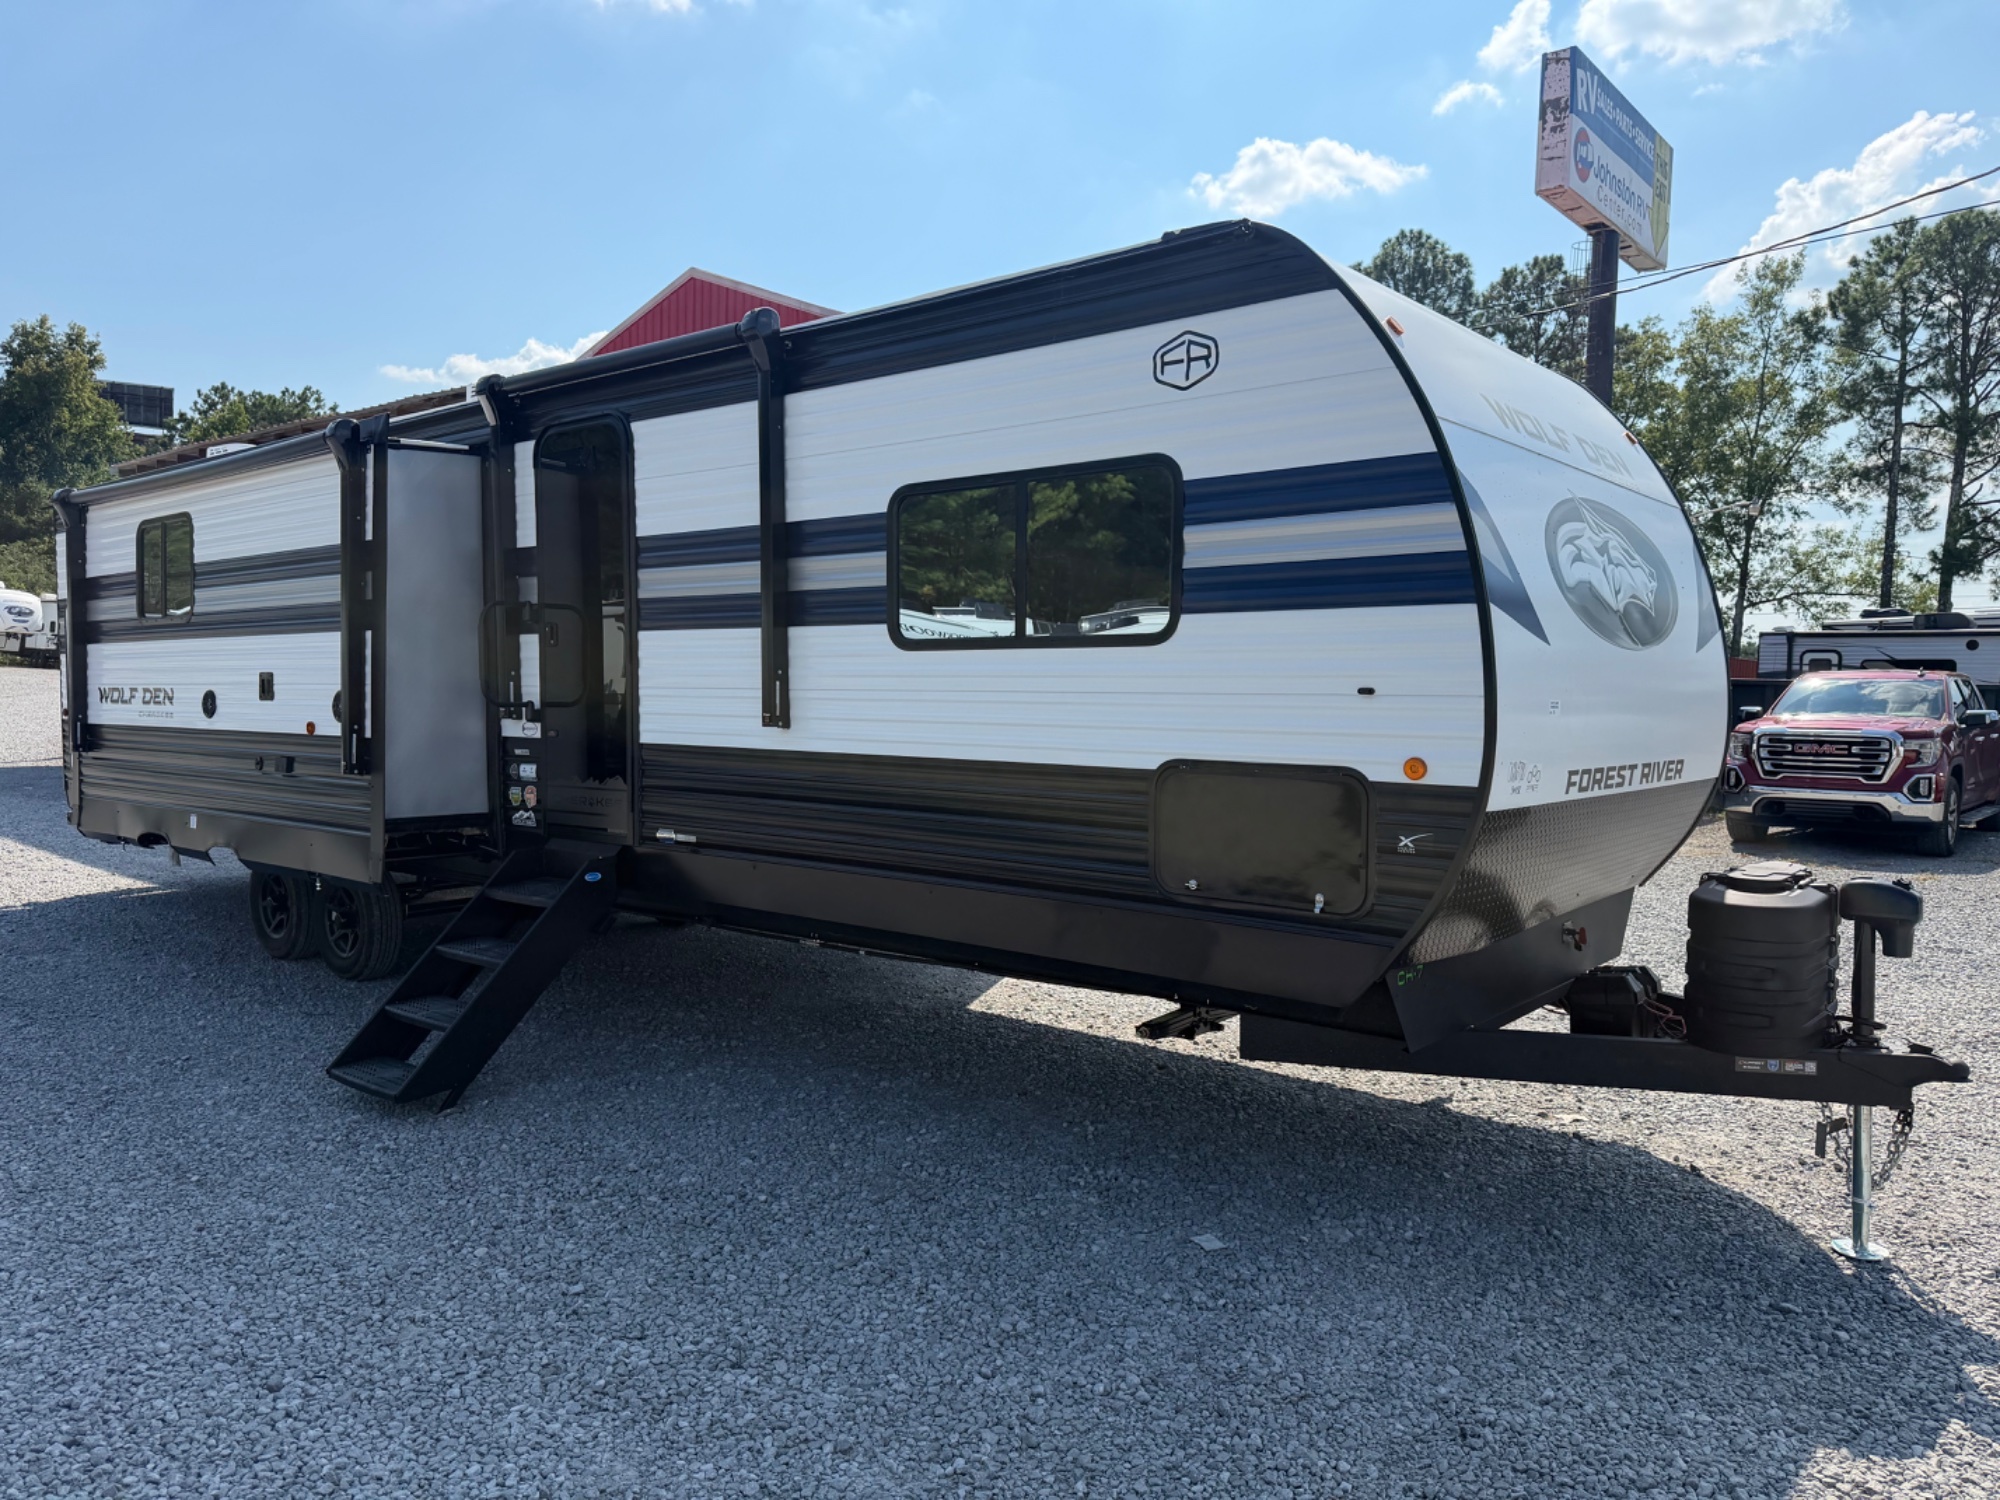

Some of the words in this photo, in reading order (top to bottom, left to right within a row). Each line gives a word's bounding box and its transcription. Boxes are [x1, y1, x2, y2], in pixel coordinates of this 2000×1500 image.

[1576, 68, 1598, 114] RV
[1593, 154, 1635, 211] Johnston
[1636, 195, 1649, 220] RV
[1597, 184, 1642, 236] Center.com
[1479, 392, 1571, 454] WOLF
[1572, 432, 1635, 480] DEN
[97, 686, 139, 705] WOLF
[142, 687, 175, 706] DEN
[1793, 743, 1849, 755] GMC
[1564, 763, 1638, 795] FOREST
[1639, 758, 1685, 785] RIVER
